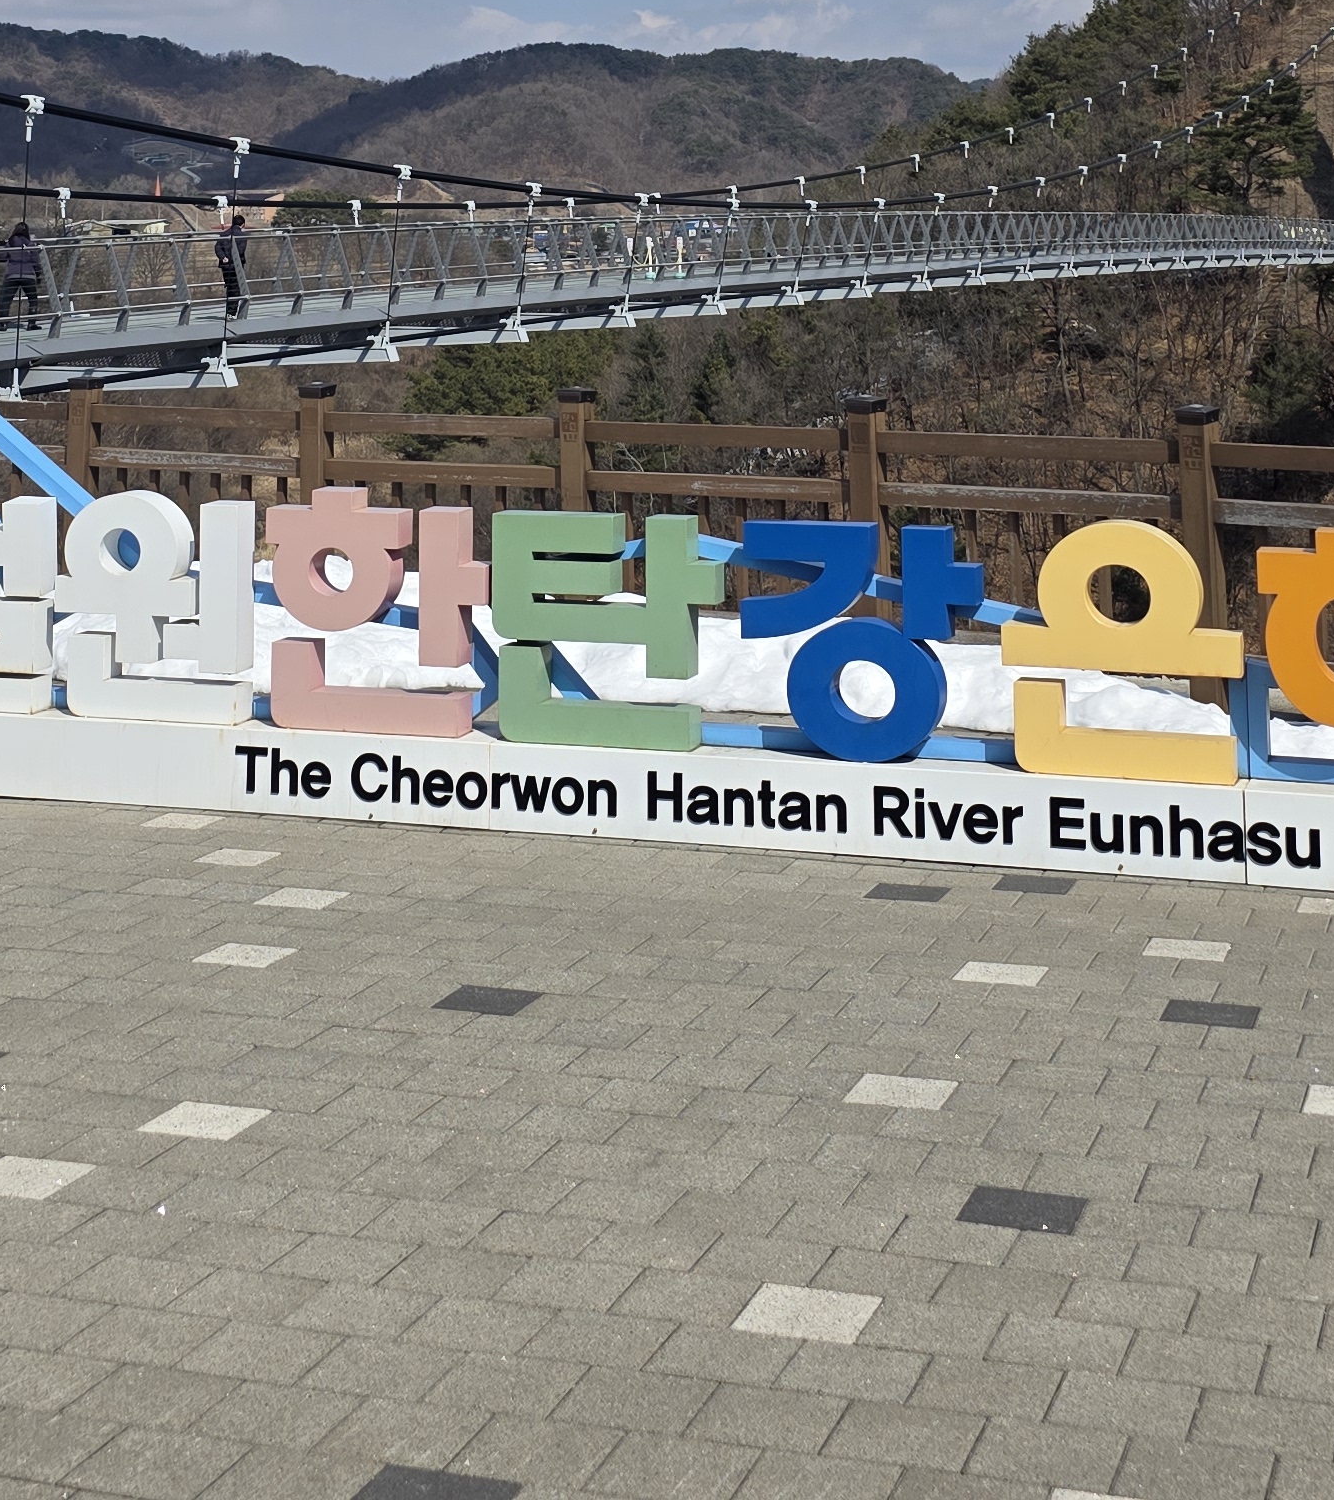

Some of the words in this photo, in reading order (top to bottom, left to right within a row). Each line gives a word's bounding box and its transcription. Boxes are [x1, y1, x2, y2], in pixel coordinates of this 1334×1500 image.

[236, 746, 332, 798] The
[351, 752, 617, 818] Cheorwon
[647, 770, 848, 834] Hantan
[873, 785, 1024, 846] River
[1049, 796, 1321, 870] Eunhasu
